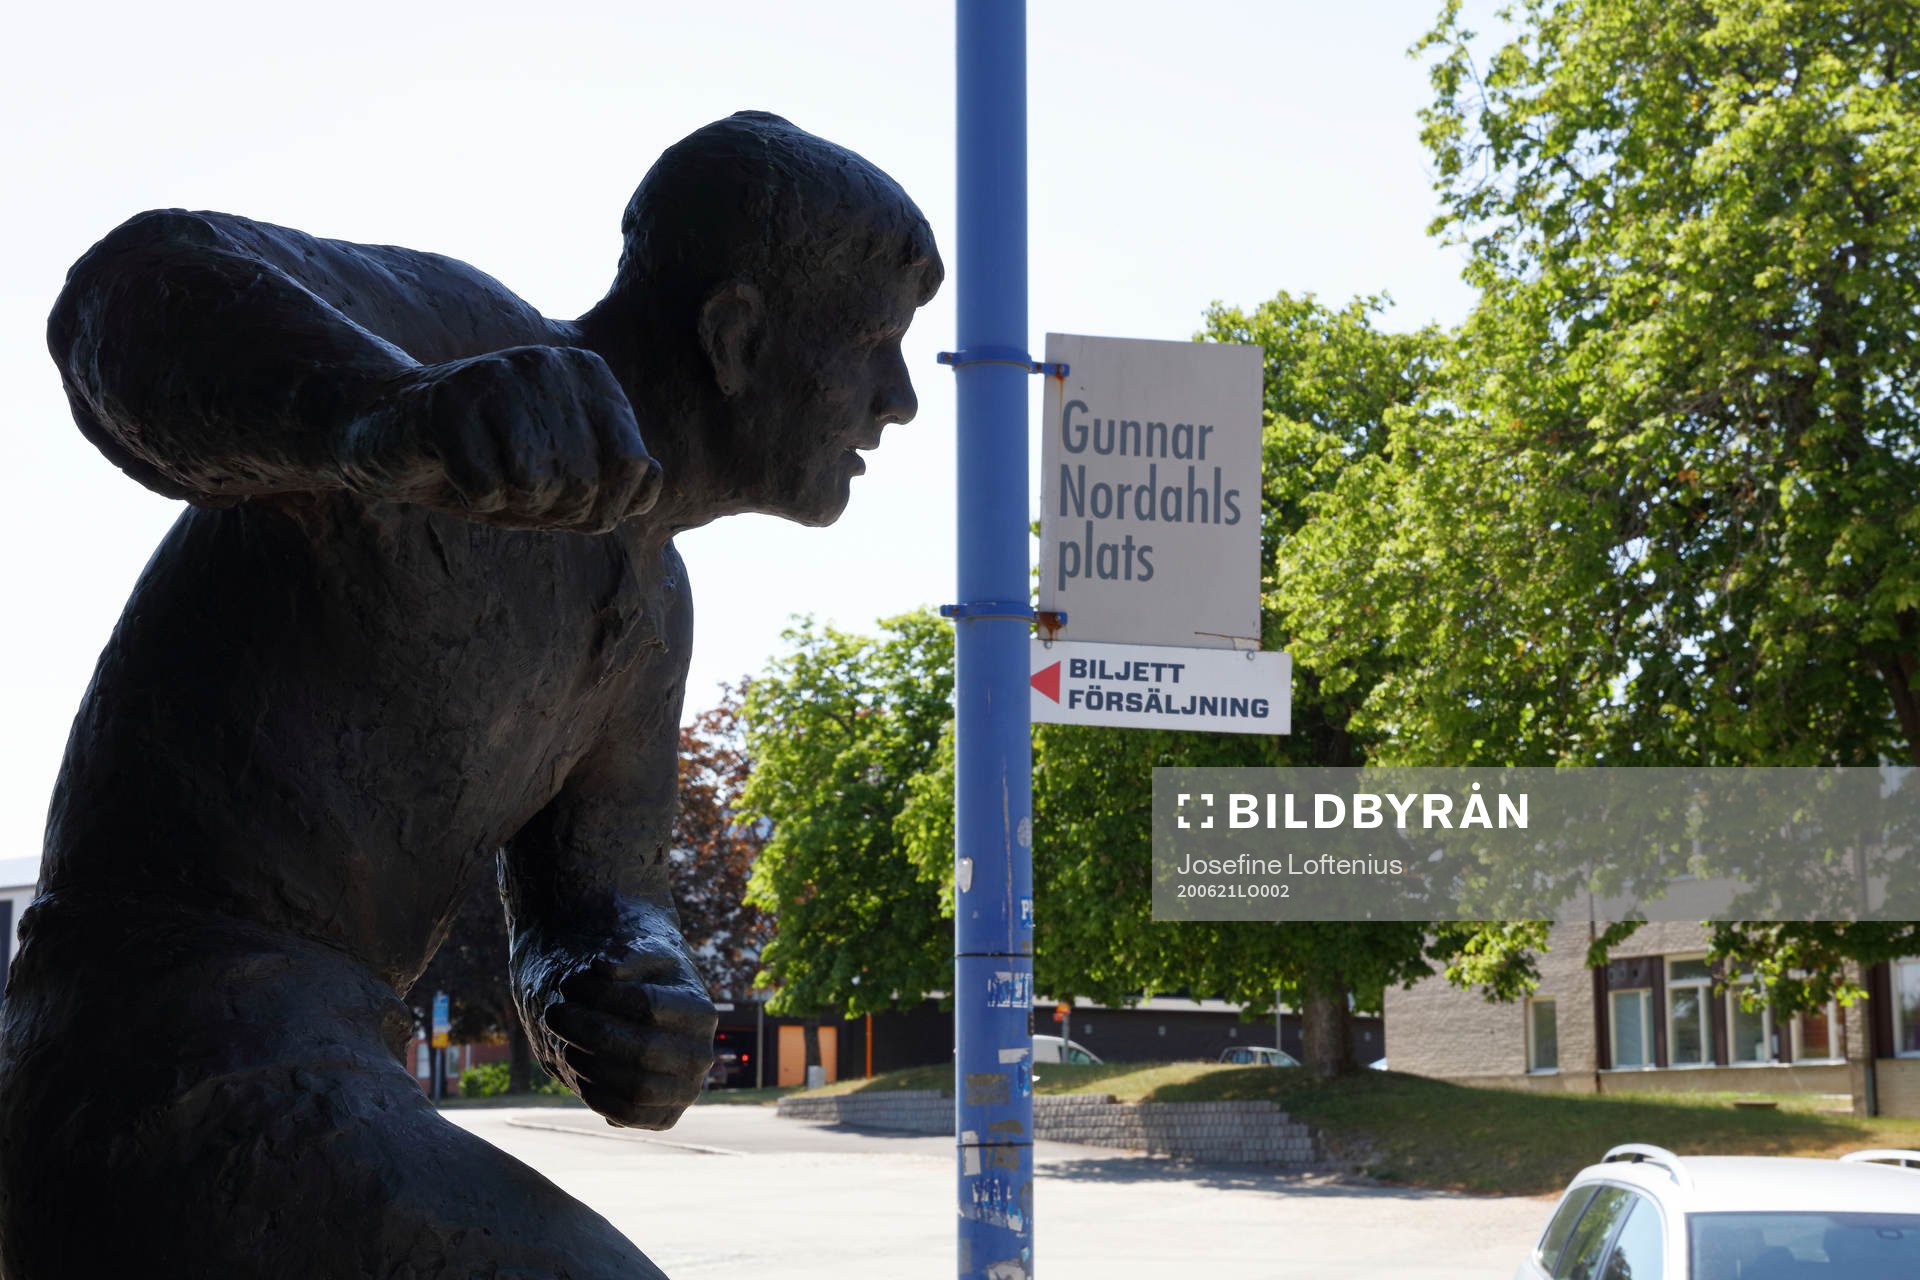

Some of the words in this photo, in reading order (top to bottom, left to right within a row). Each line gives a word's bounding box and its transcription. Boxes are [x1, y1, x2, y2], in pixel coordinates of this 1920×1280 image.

[1062, 399, 1214, 460] Gunnar
[1059, 463, 1241, 525] Nordahls
[1057, 520, 1155, 591] plats
[1069, 658, 1185, 683] BILJETT
[1068, 685, 1270, 719] FÖRSÄLJNING
